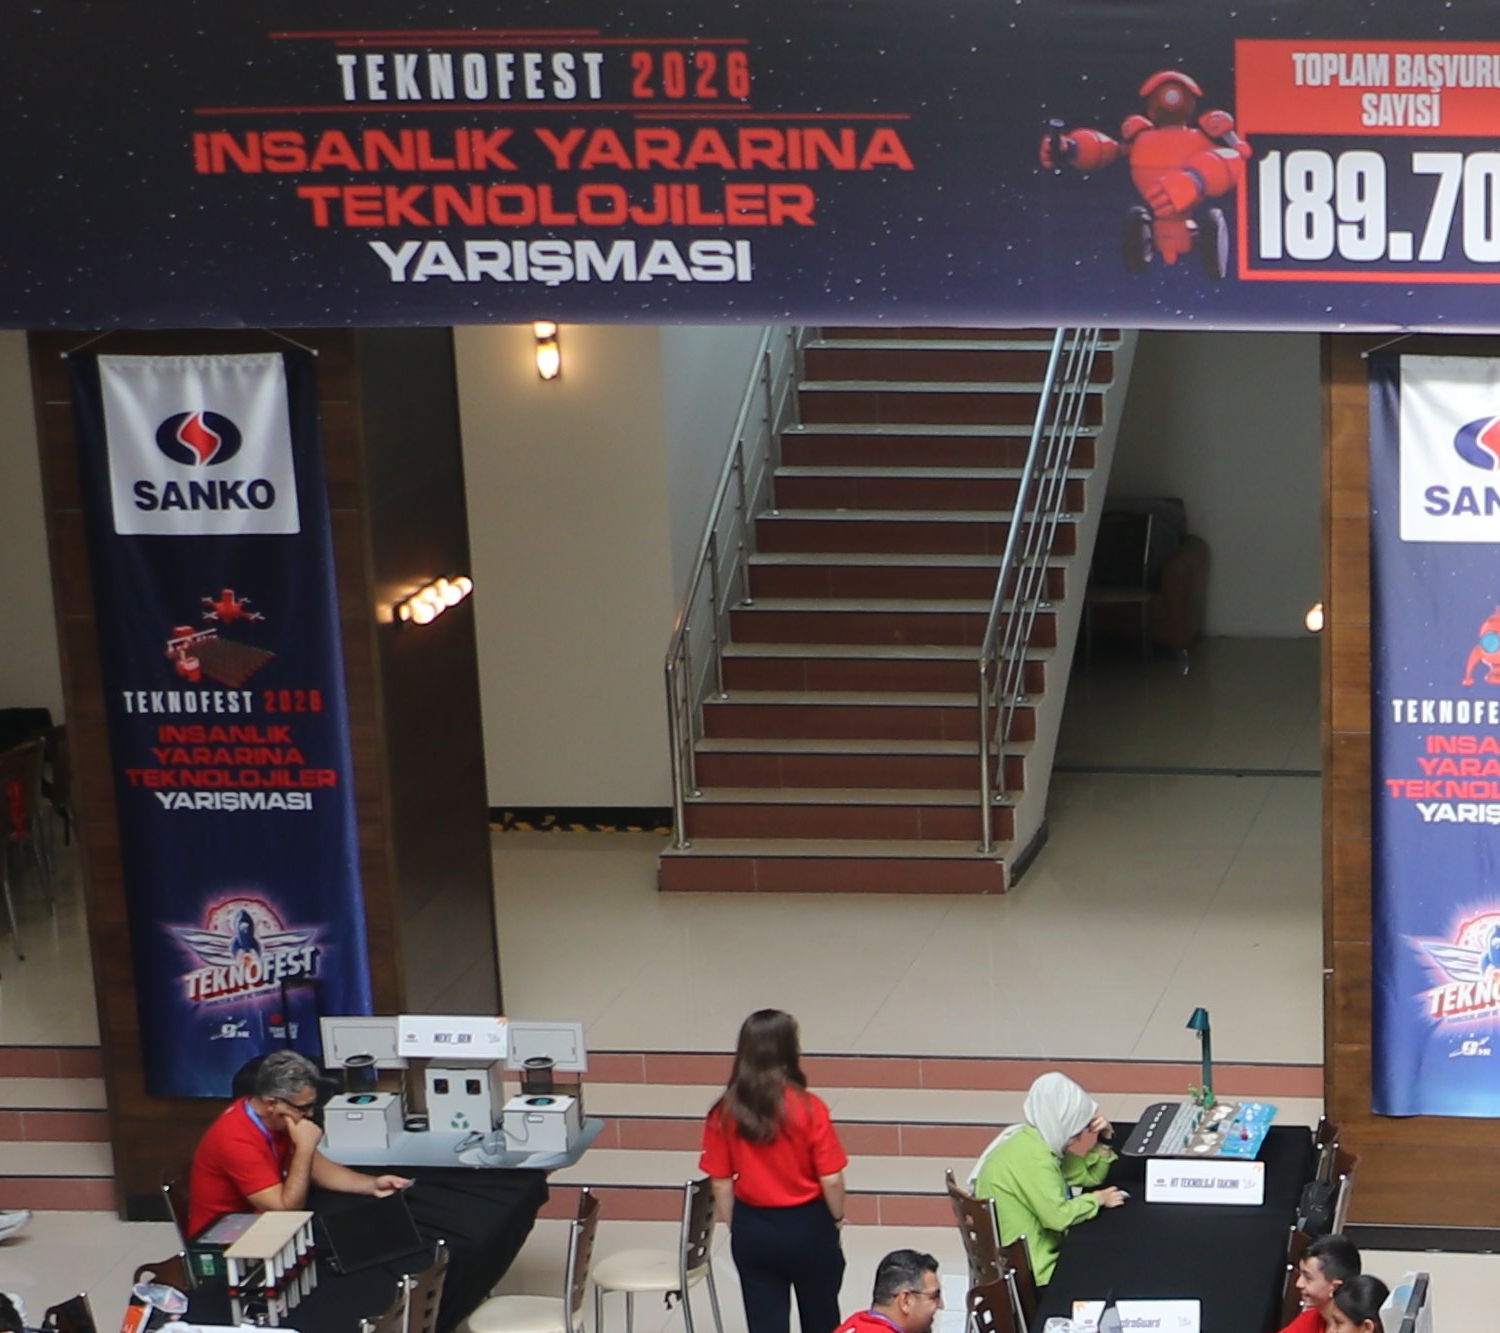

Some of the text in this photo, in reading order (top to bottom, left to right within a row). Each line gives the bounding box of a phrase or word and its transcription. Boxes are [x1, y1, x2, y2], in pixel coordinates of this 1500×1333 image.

[337, 51, 752, 102] TEKNOFEST 2026
[1292, 52, 1391, 89] TOPLAM
[1361, 93, 1441, 127] SAYISI
[534, 127, 914, 171] YARARINA
[368, 239, 754, 287] YARIŞMASI
[132, 478, 276, 512] SANKO
[123, 689, 323, 714] TEKNOFEST 2026
[152, 747, 306, 766] YARARINA
[155, 792, 313, 812] YARIŞMASI
[182, 946, 320, 1003] TEKNOFEST
